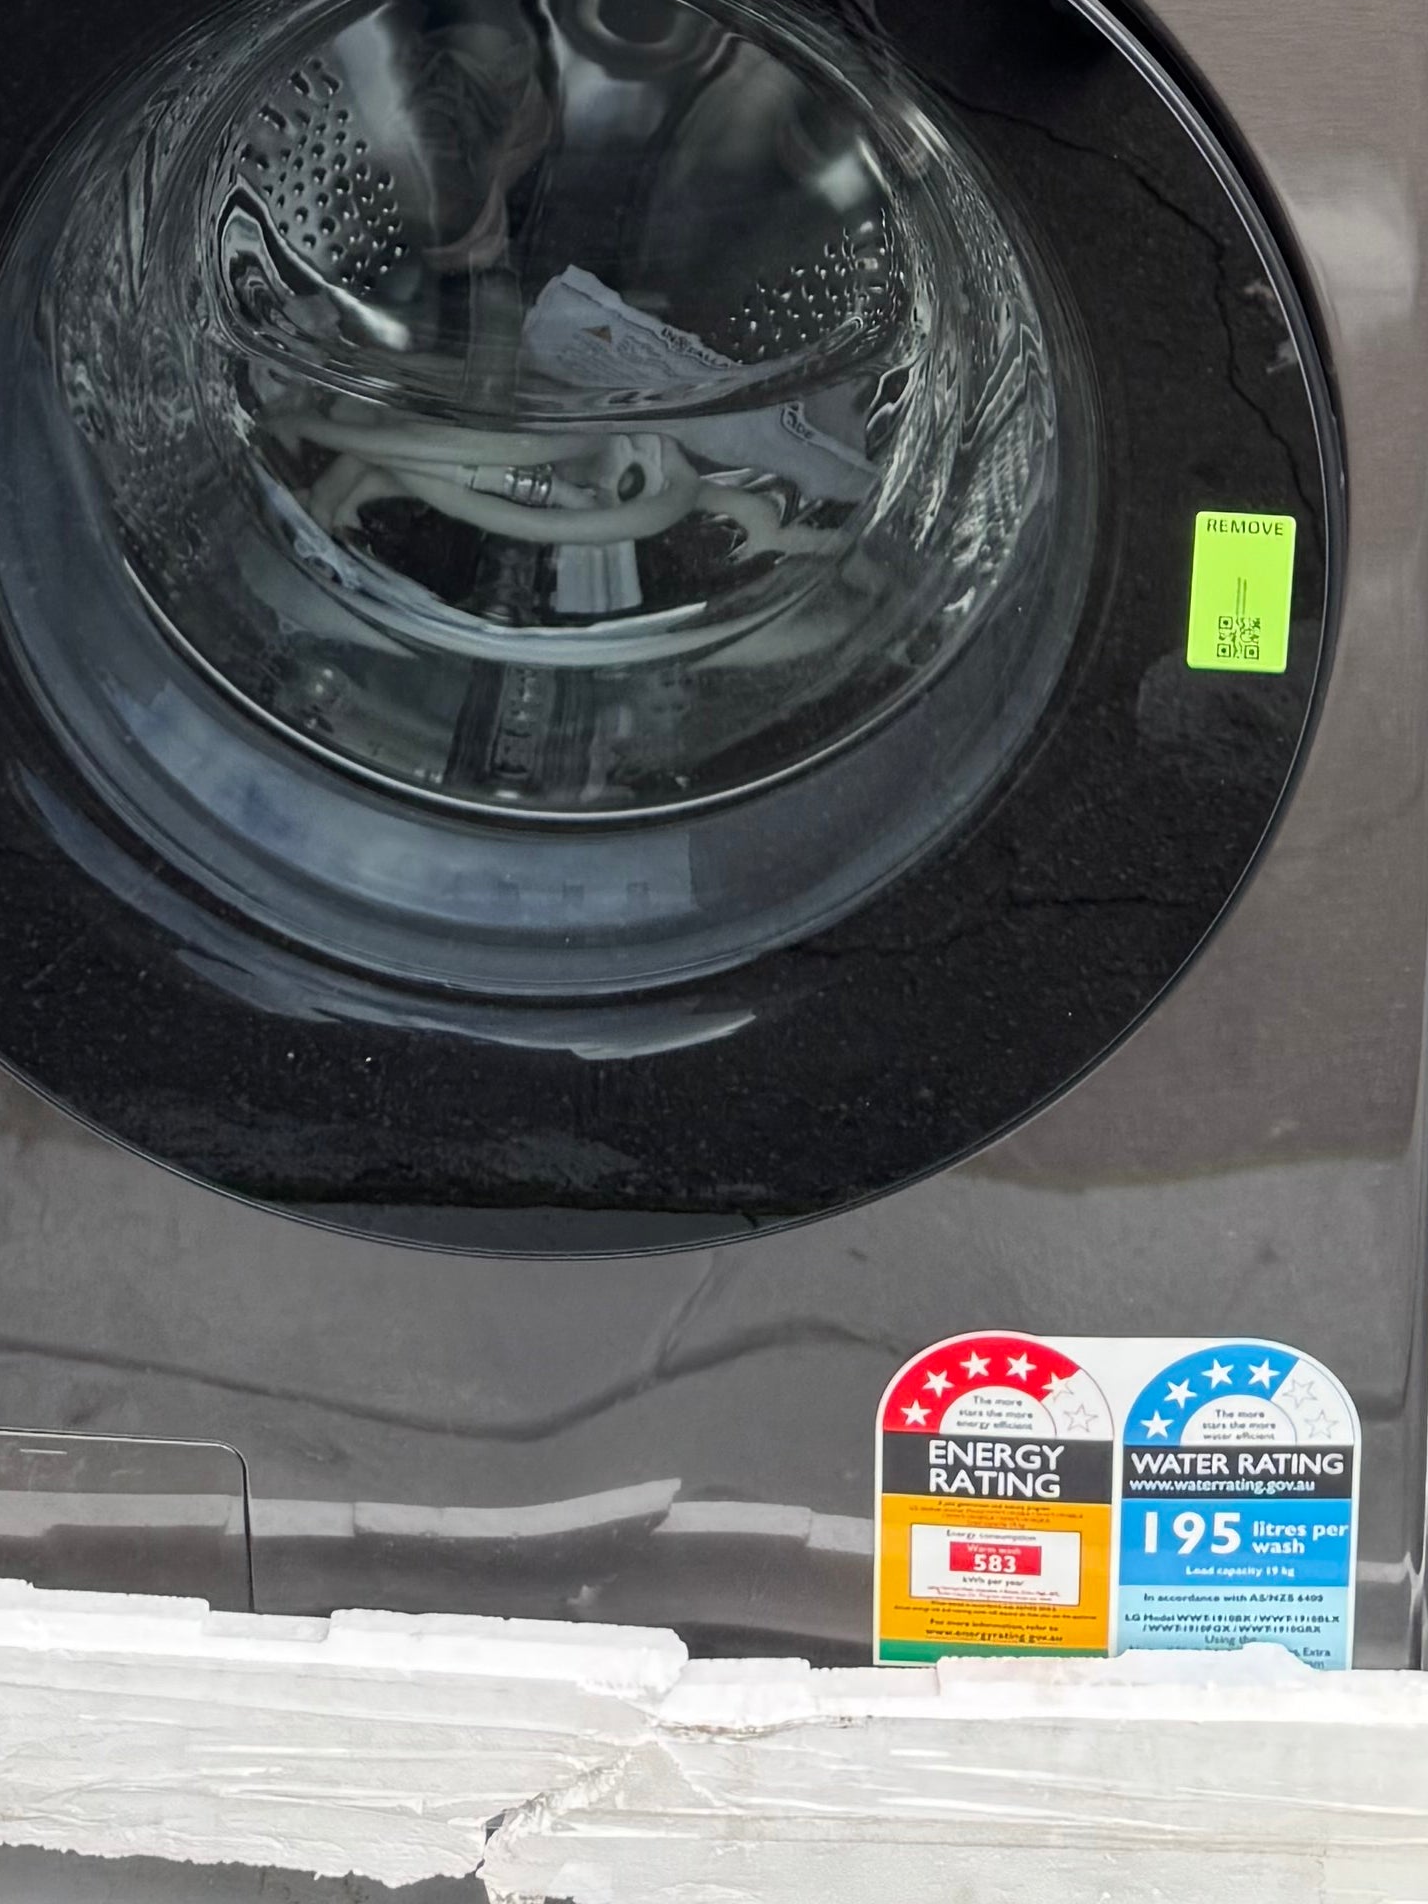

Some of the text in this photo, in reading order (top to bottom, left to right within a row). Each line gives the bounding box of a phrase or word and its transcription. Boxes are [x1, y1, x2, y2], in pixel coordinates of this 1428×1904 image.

[1207, 519, 1284, 536] REMOVE
[973, 1395, 991, 1405] The
[1215, 1409, 1234, 1418] The
[928, 1439, 1065, 1470] ENERGY
[1131, 1453, 1344, 1475] WATER RATING
[929, 1467, 1061, 1498] RATING
[1130, 1479, 1315, 1494] www.waterrating.gov.au
[1145, 1511, 1241, 1555] 195
[1252, 1521, 1349, 1541] litres per
[1252, 1538, 1305, 1554] wash
[973, 1554, 1017, 1573] 583
[1186, 1566, 1214, 1575] Load
[1144, 1593, 1155, 1602] In
[1303, 1648, 1331, 1657] Extra
